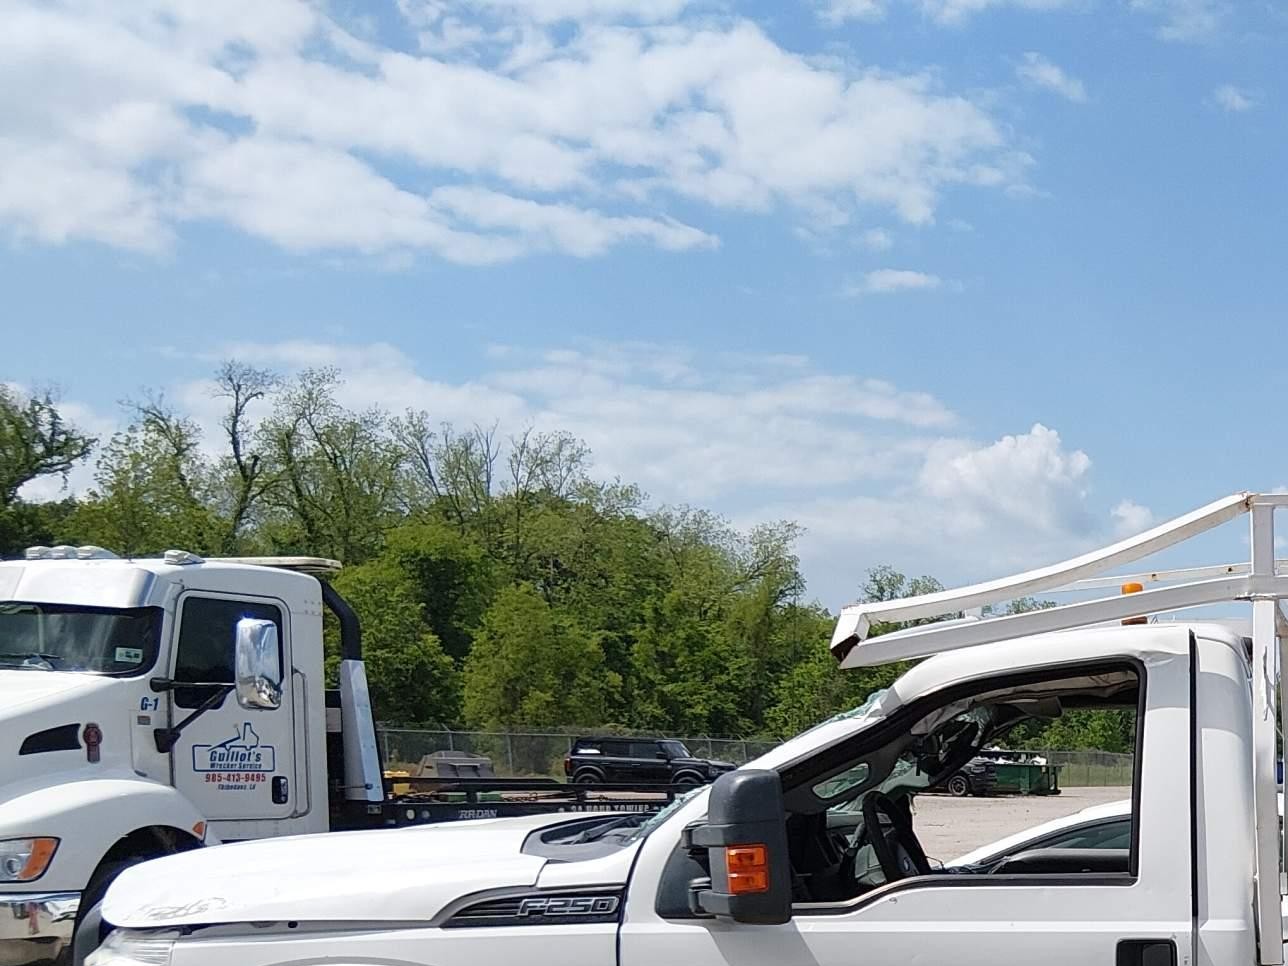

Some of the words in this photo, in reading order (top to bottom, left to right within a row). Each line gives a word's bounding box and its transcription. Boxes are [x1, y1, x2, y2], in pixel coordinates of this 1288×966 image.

[140, 696, 159, 711] G-1
[209, 751, 262, 762] Guillot's
[517, 895, 619, 917] F-250
